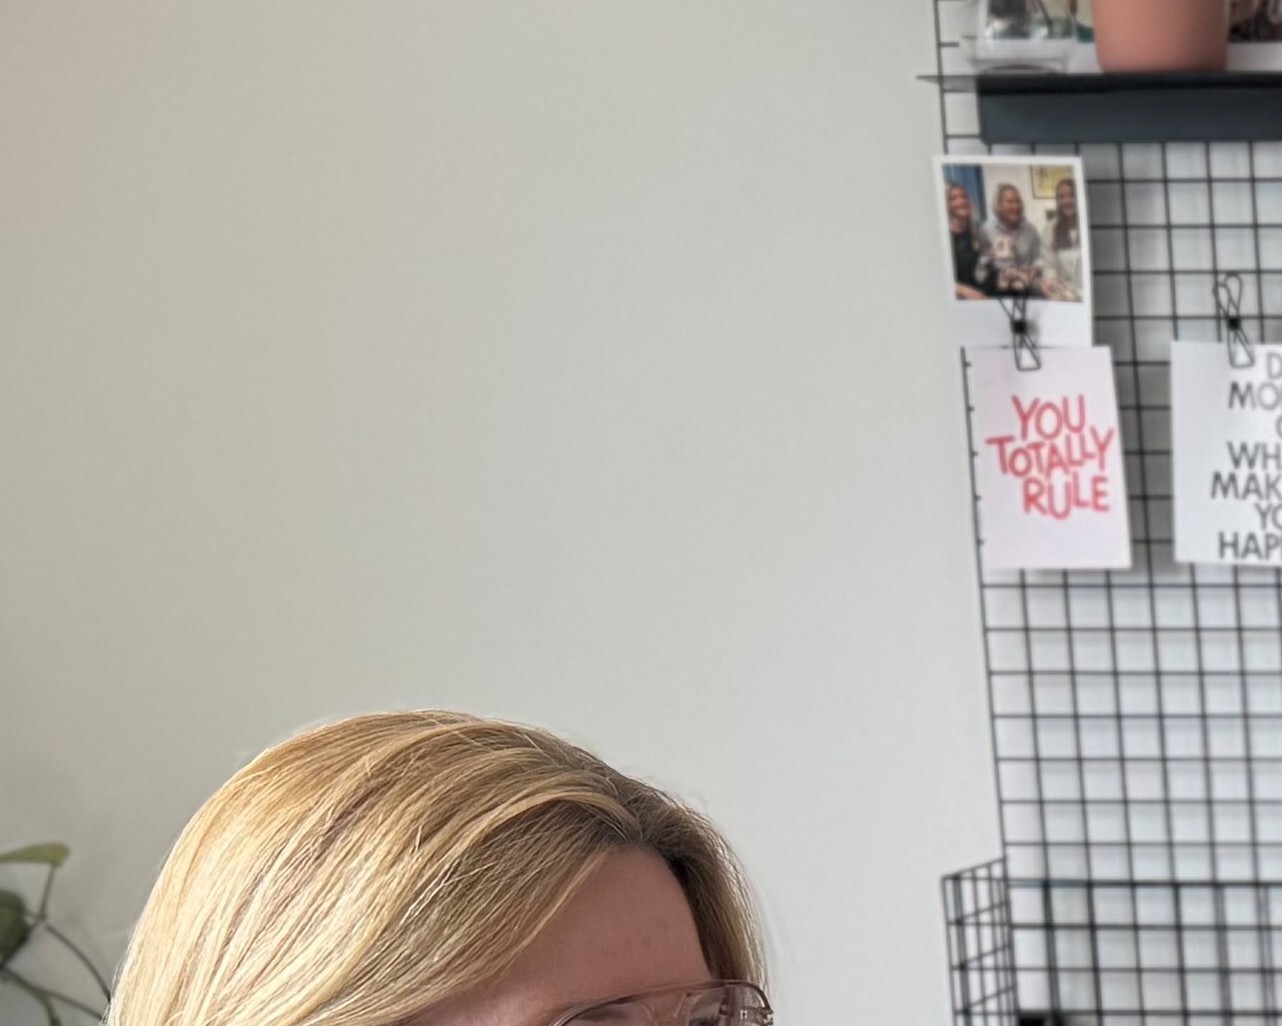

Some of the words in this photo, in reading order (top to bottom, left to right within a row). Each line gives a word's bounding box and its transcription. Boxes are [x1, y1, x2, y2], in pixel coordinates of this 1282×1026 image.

[1011, 394, 1085, 440] YOU
[985, 425, 1114, 480] TOTALLY
[1023, 472, 1110, 520] RULE
